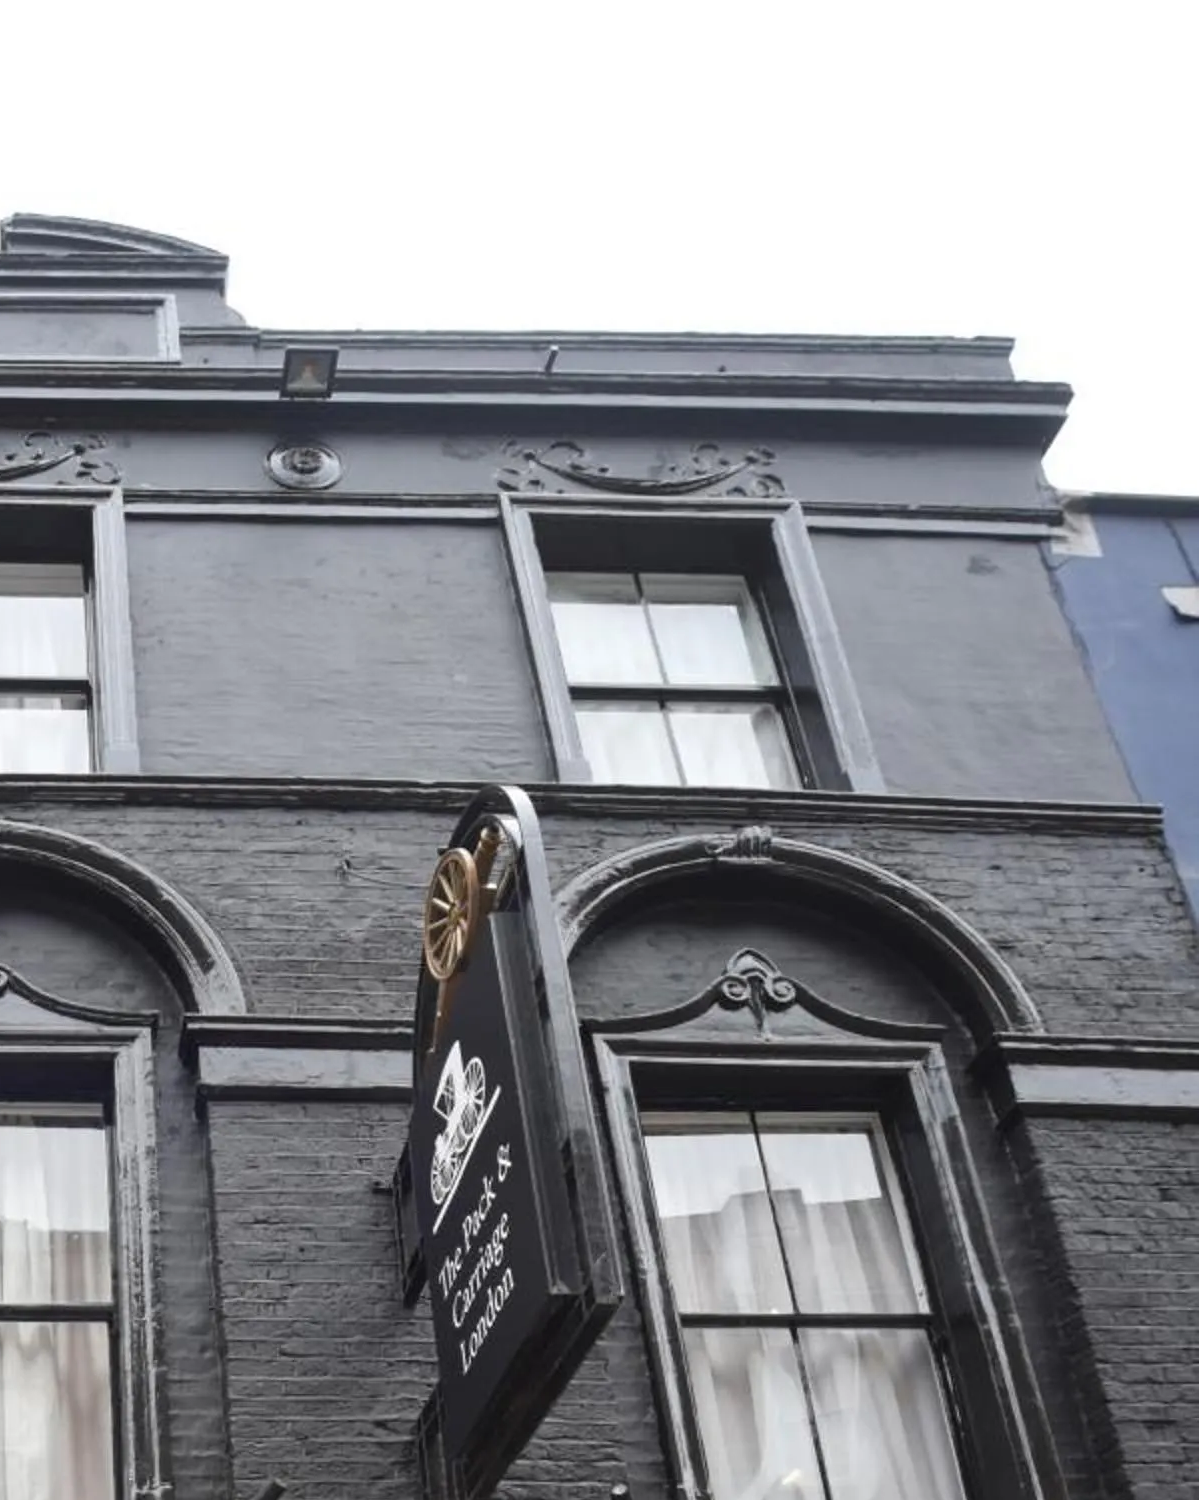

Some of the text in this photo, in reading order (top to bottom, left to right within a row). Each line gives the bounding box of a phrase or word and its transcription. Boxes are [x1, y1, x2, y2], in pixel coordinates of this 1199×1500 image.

[439, 1143, 512, 1299] The Pack &
[452, 1212, 510, 1328] Carriage
[459, 1267, 515, 1375] London
